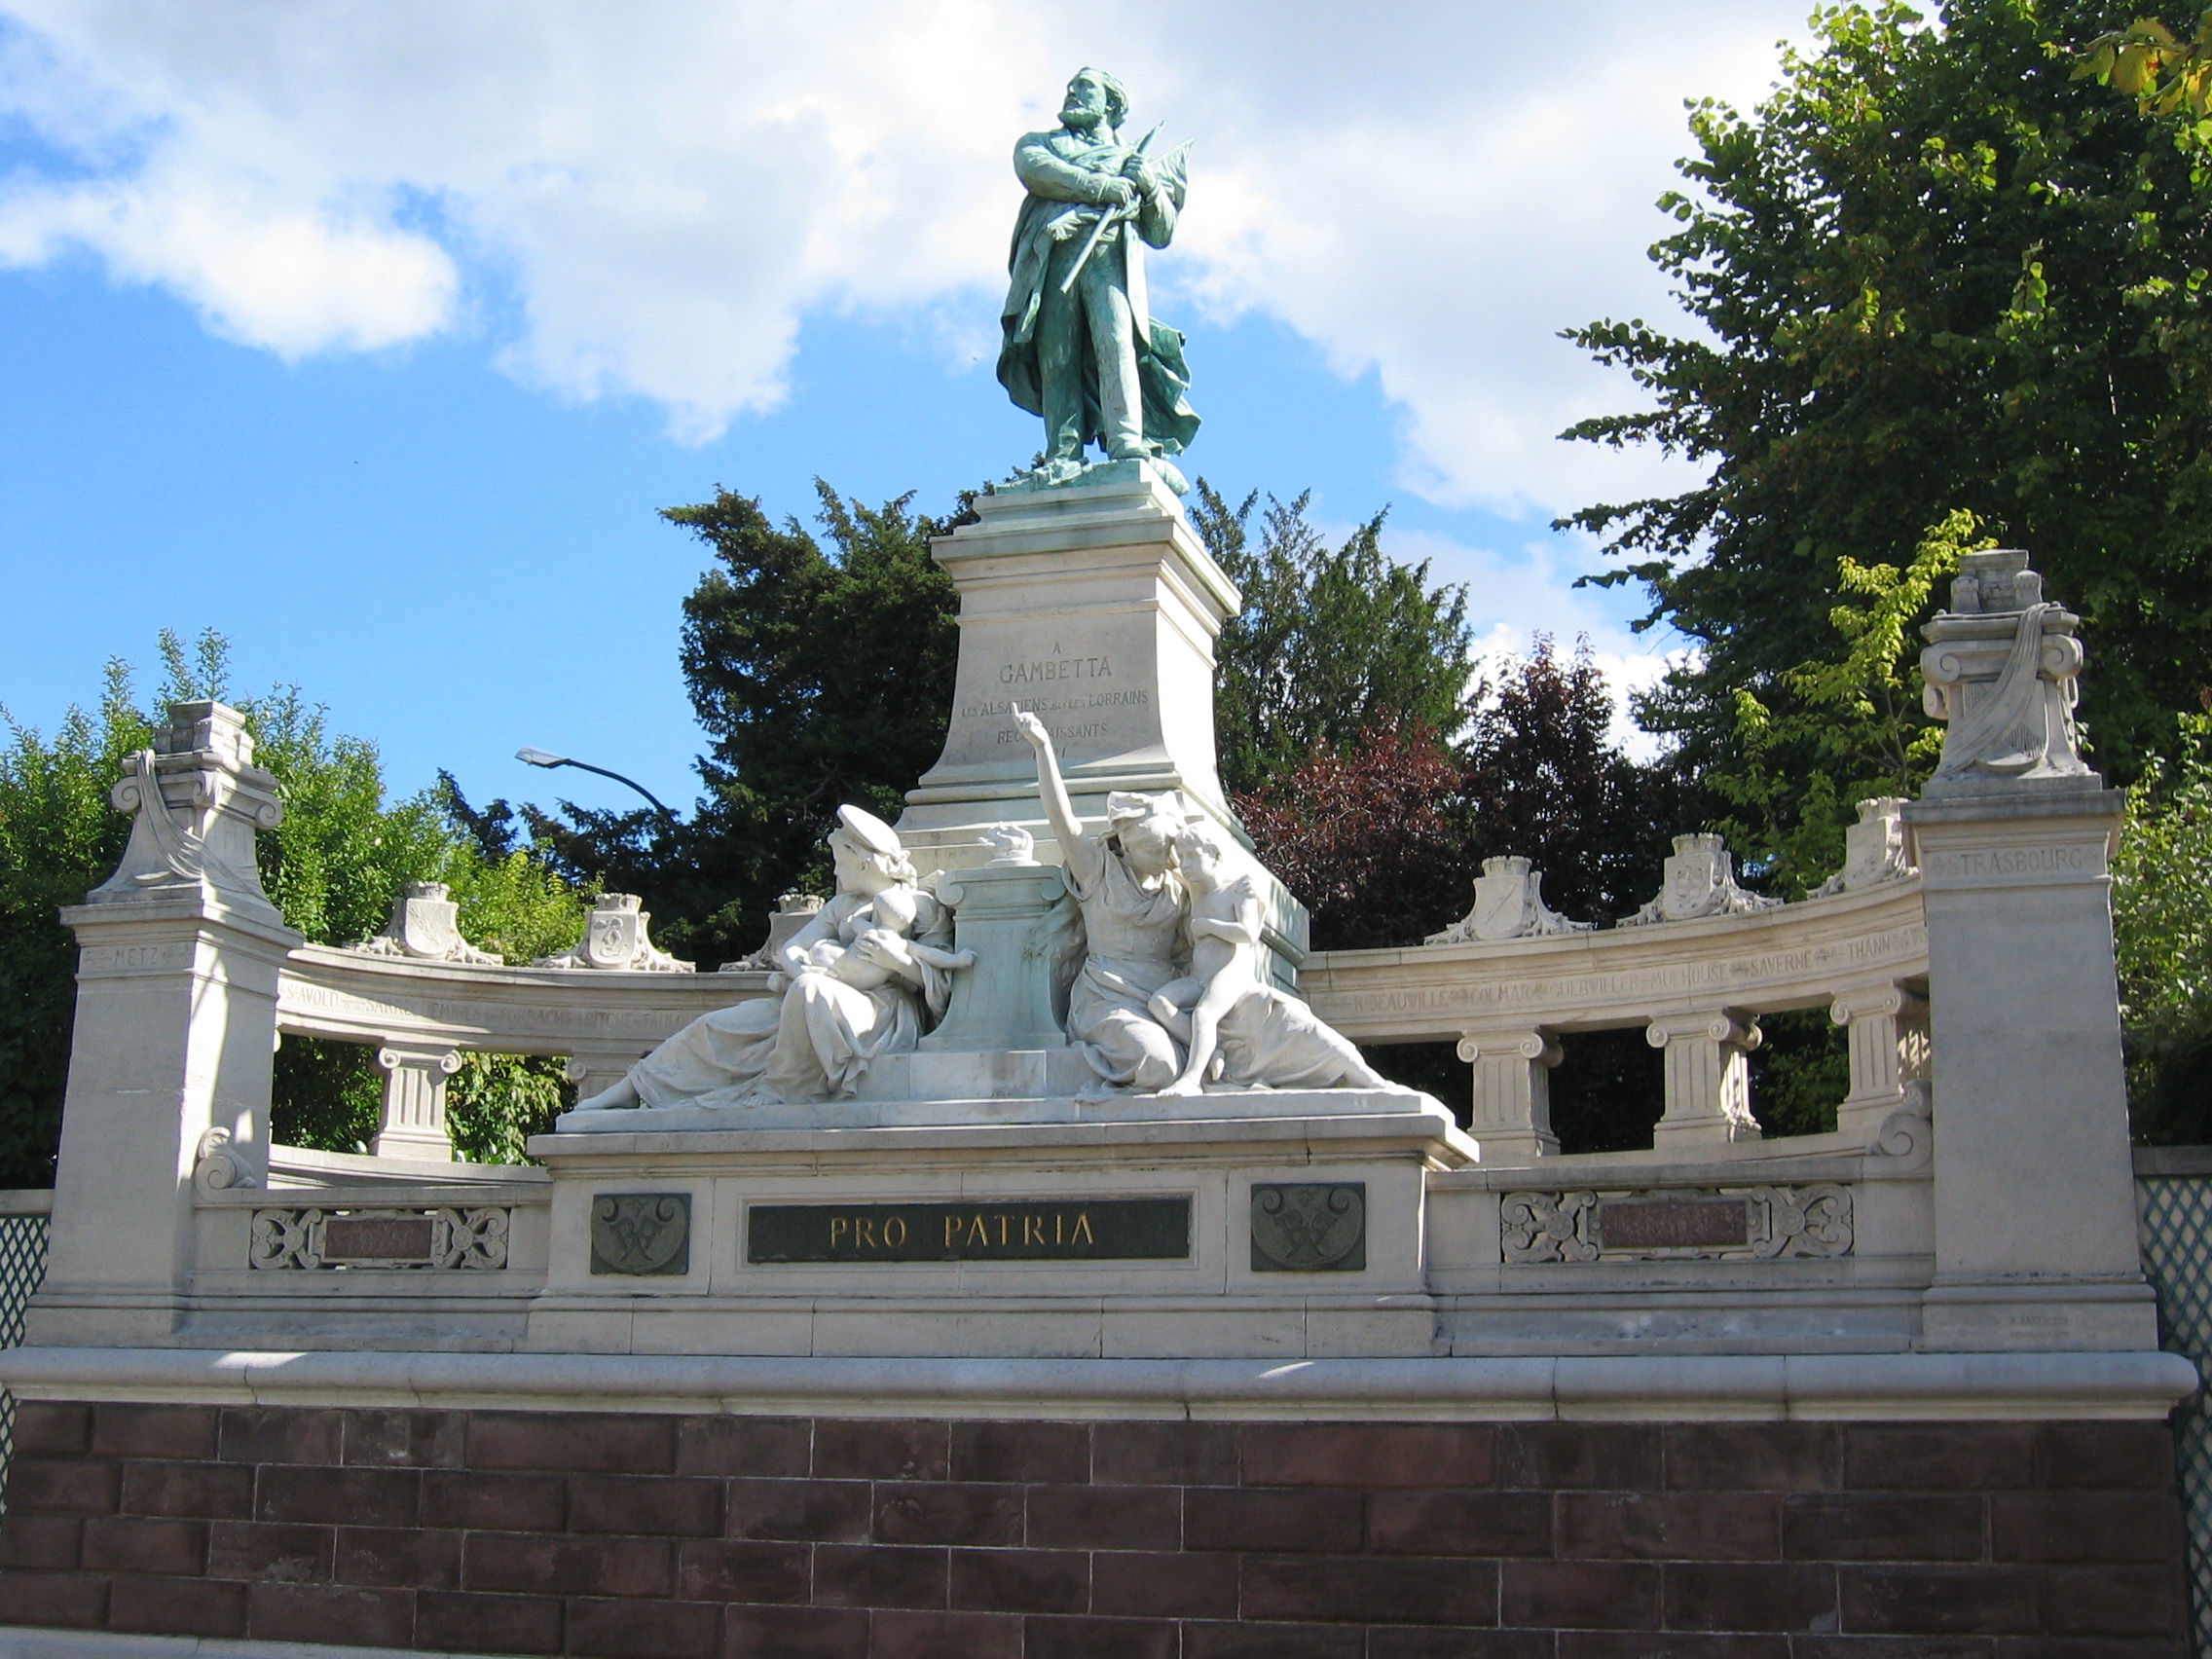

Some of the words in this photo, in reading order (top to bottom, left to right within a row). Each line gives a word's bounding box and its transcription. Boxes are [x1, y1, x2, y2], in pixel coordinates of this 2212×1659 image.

[1051, 642, 1061, 654] A
[1000, 657, 1112, 683] GAMBETTA
[1088, 689, 1148, 708] LORRAINS
[1948, 848, 2083, 876] STRASBOURG
[114, 946, 158, 967] METZ
[1469, 983, 1530, 1005] COLMAR
[1651, 962, 1728, 989] MULHOUSE
[1750, 949, 1812, 977] SAVERNE
[1847, 935, 1891, 962] THANN
[829, 1217, 907, 1249] PRO
[944, 1212, 1095, 1248] PATRIA
